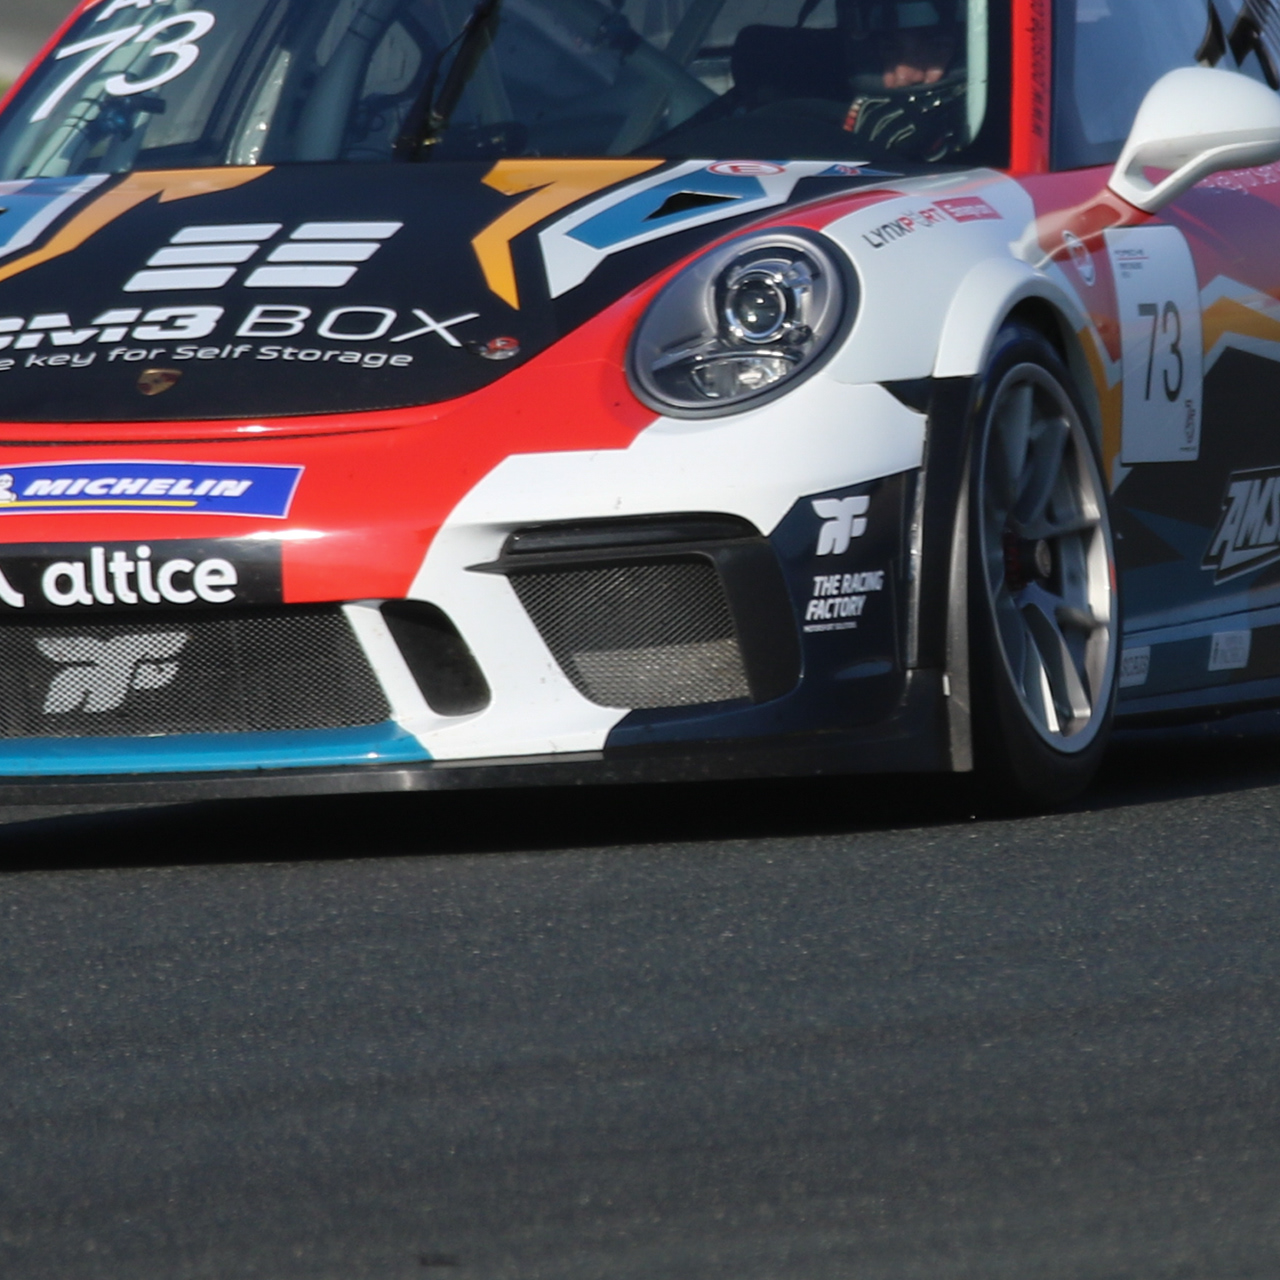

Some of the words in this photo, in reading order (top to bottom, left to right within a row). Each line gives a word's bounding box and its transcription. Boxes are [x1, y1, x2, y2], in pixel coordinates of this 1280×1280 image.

[29, 10, 215, 124] 73
[234, 306, 480, 348] BOX
[24, 351, 97, 368] key
[107, 346, 167, 362] for
[173, 343, 249, 362] Self
[256, 344, 413, 368] Storage
[1137, 300, 1183, 402] 73
[23, 477, 253, 497] MICHELIN
[42, 545, 238, 607] altice
[812, 575, 842, 597] THE
[842, 570, 884, 594] RACING
[805, 596, 866, 621] FACTORY
